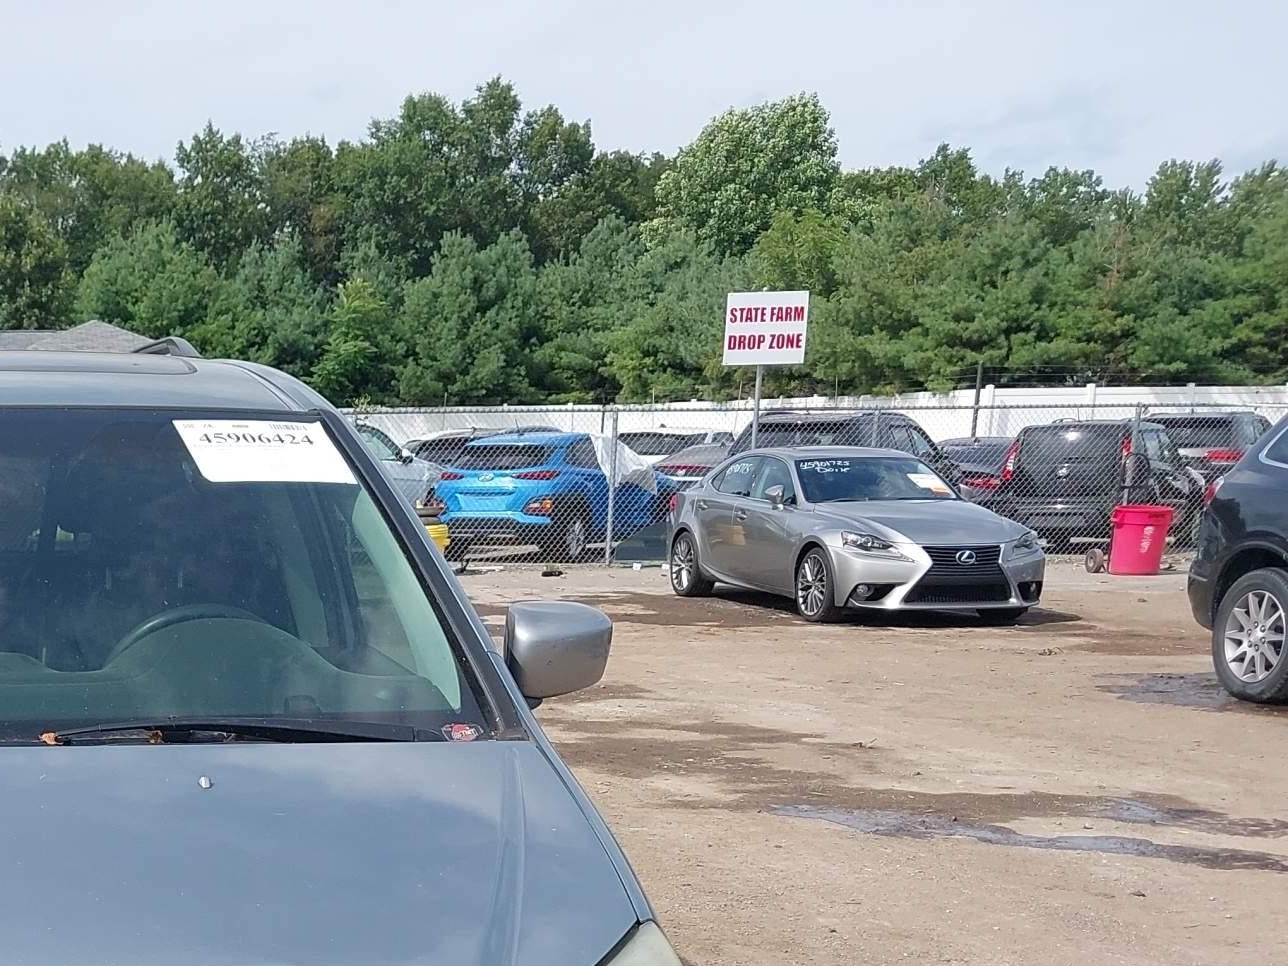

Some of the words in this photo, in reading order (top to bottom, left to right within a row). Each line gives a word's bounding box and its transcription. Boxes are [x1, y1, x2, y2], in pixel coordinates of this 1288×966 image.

[729, 307, 767, 323] STATE
[770, 306, 805, 322] FARM
[727, 334, 766, 350] DROP
[768, 333, 803, 349] ZONE
[199, 432, 314, 446] 45906424
